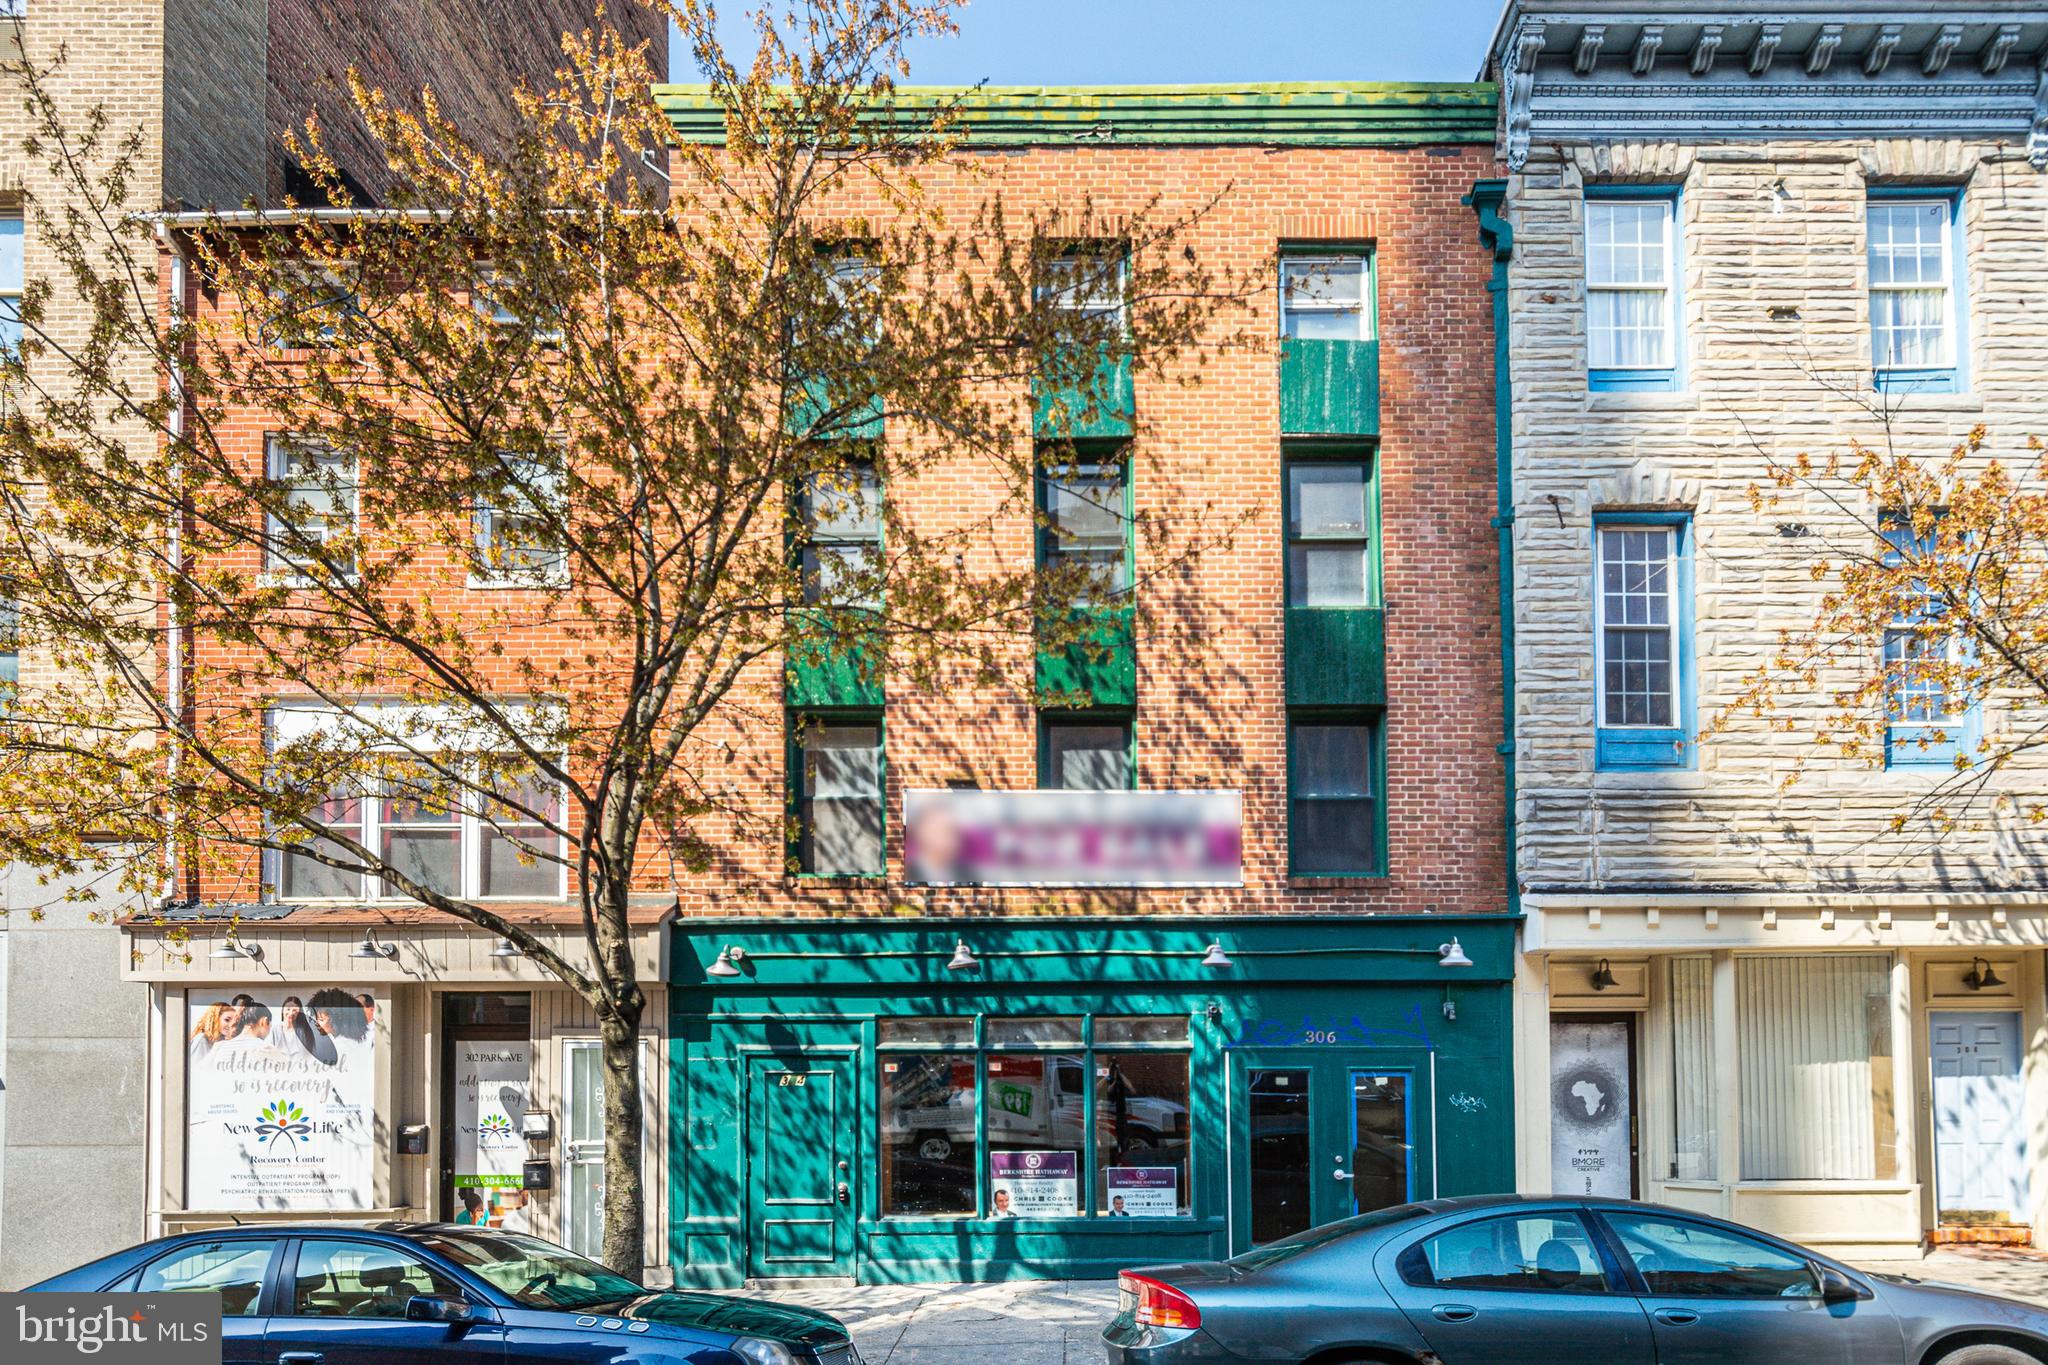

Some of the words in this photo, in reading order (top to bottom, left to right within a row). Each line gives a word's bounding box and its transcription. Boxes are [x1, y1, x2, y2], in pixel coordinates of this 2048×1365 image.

[1305, 1031, 1336, 1044] 306
[216, 1051, 294, 1073] addiction
[299, 1058, 308, 1072] is
[465, 1053, 479, 1062] 302
[480, 1053, 505, 1062] PARK
[505, 1053, 523, 1062] AVE
[232, 1079, 246, 1093] so
[250, 1080, 262, 1093] is
[223, 1122, 252, 1136] New
[312, 1121, 344, 1135] Life
[461, 1126, 477, 1134] New
[250, 1155, 292, 1166] Recovery
[295, 1155, 327, 1164] Center
[1571, 1157, 1605, 1166] BMORE
